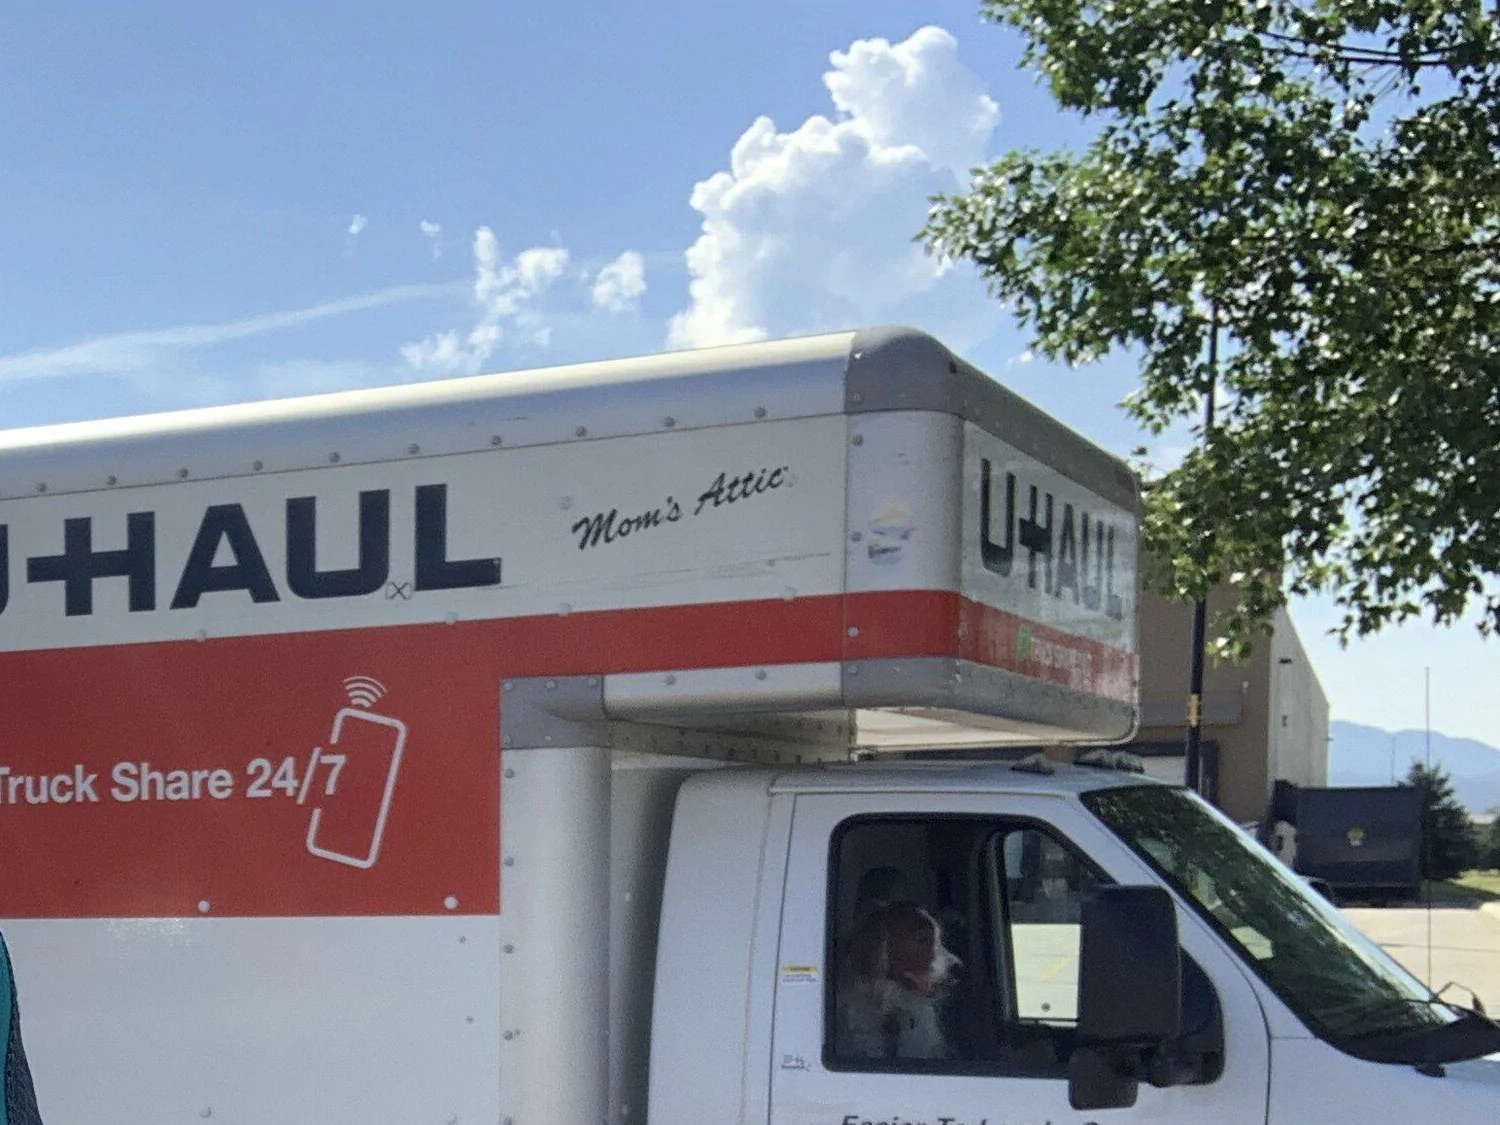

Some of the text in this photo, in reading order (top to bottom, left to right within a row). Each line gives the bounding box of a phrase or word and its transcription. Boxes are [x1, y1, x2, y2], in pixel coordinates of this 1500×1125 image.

[572, 466, 785, 550] Mom's Attic
[111, 761, 233, 802] Share
[246, 746, 348, 805] 24/7
